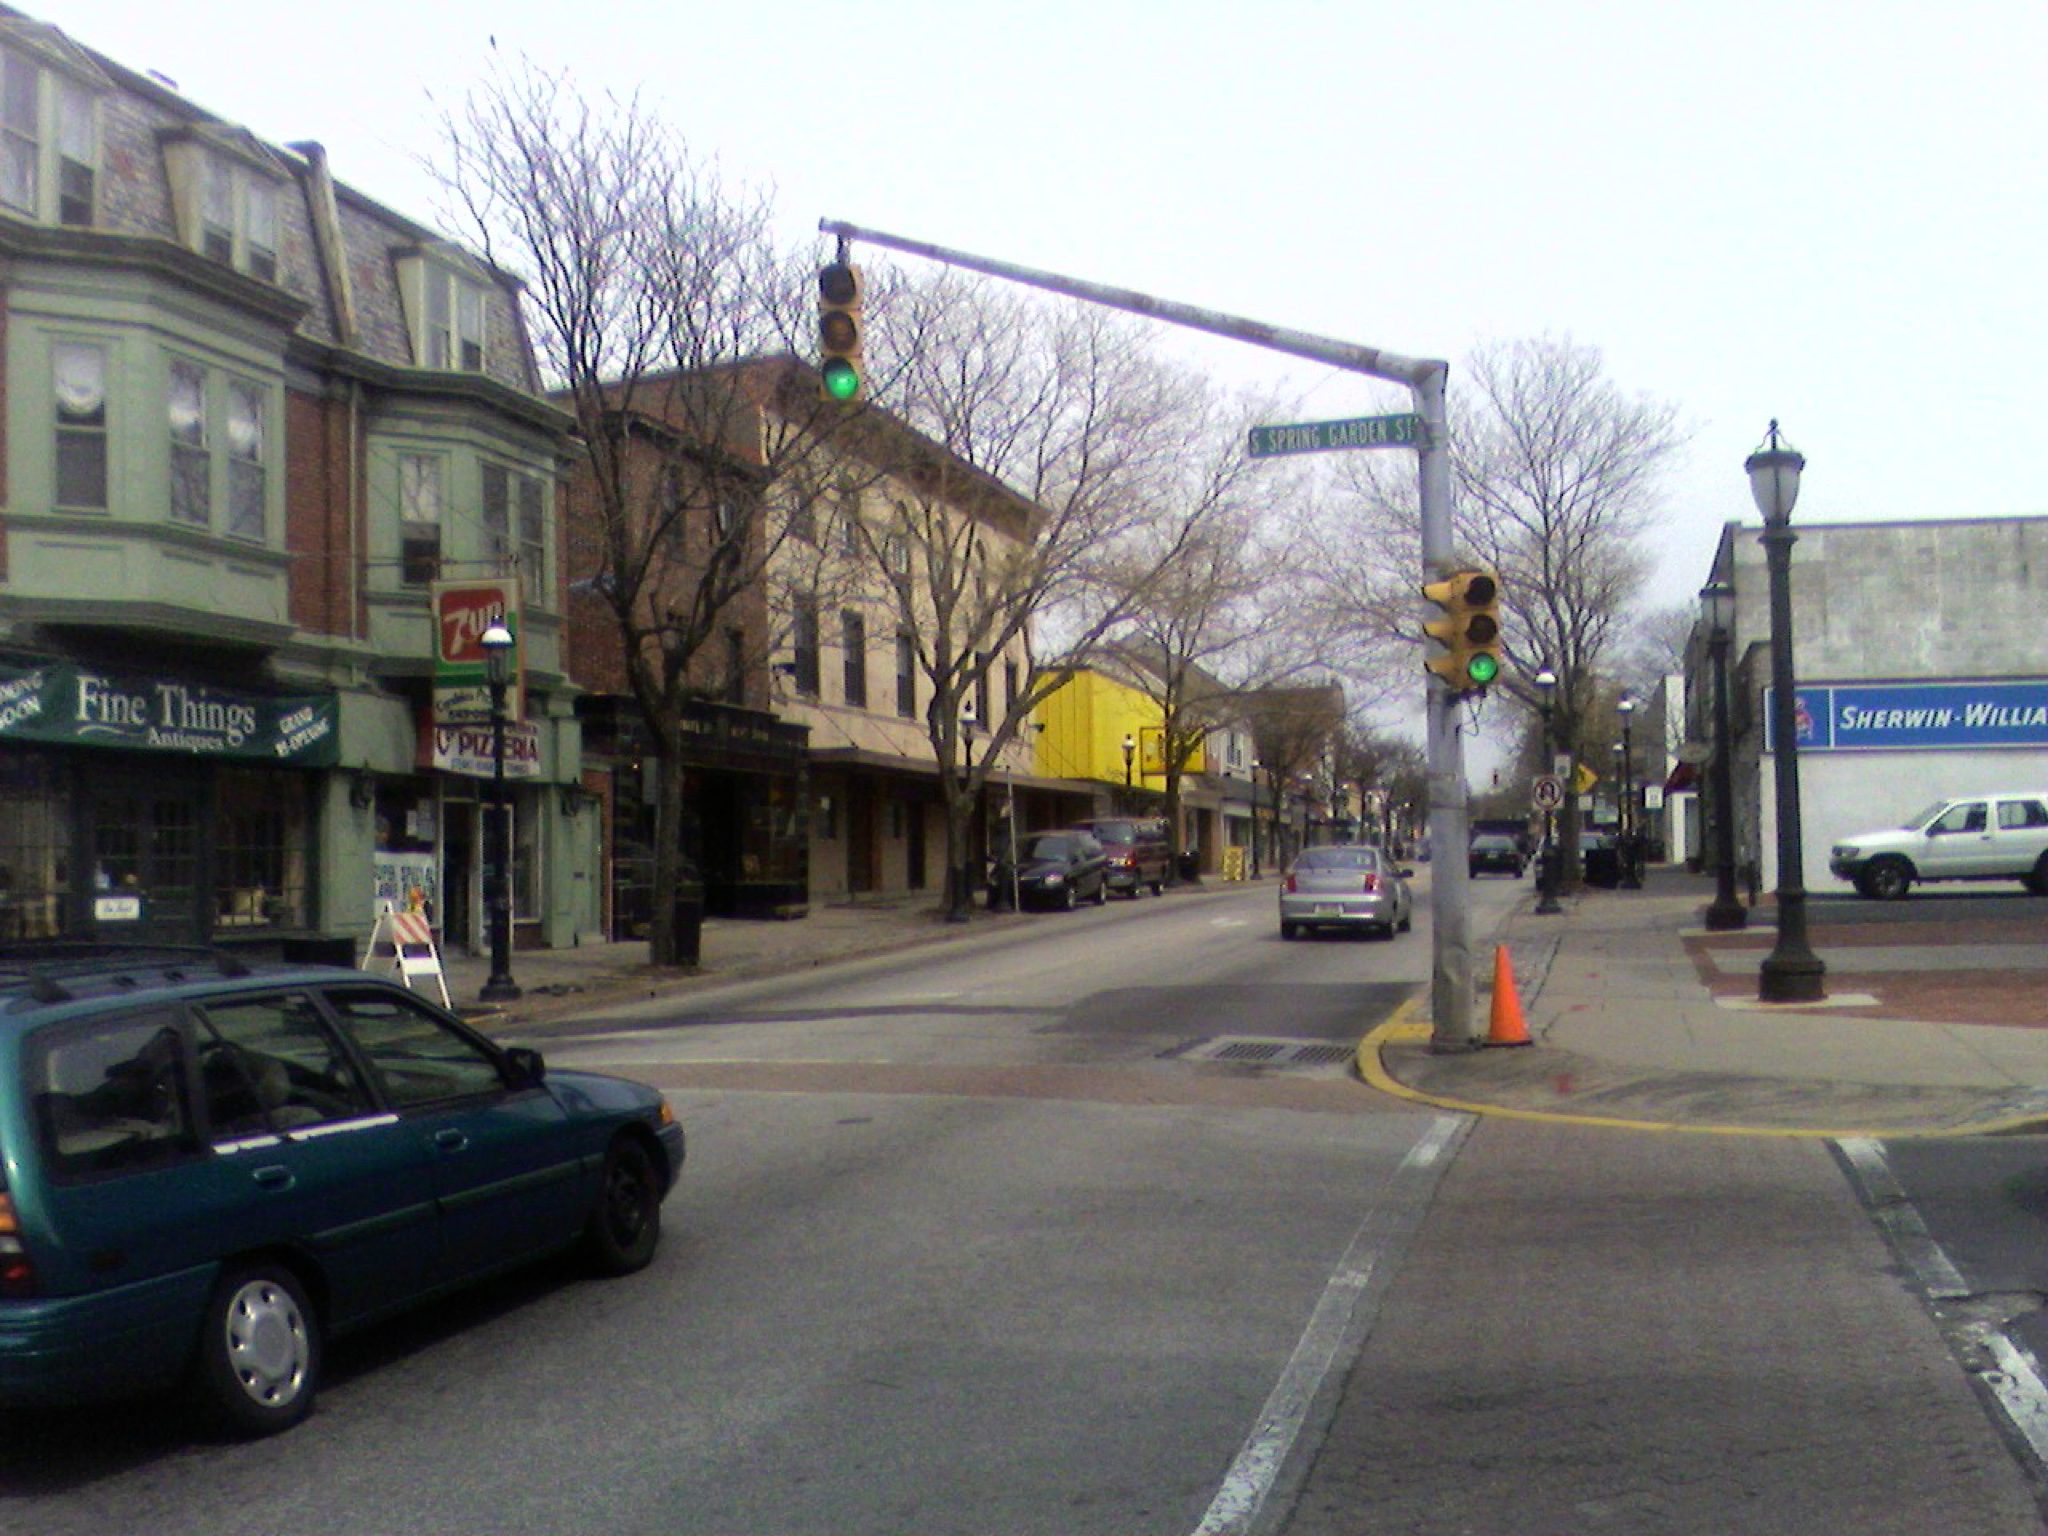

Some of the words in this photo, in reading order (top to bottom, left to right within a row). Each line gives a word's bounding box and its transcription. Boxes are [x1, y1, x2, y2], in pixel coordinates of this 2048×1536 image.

[1268, 427, 1321, 452] SPRING
[1328, 419, 1387, 447] GARDEN
[75, 674, 147, 725] Fine
[155, 682, 256, 747] Things
[148, 726, 225, 752] Antiques
